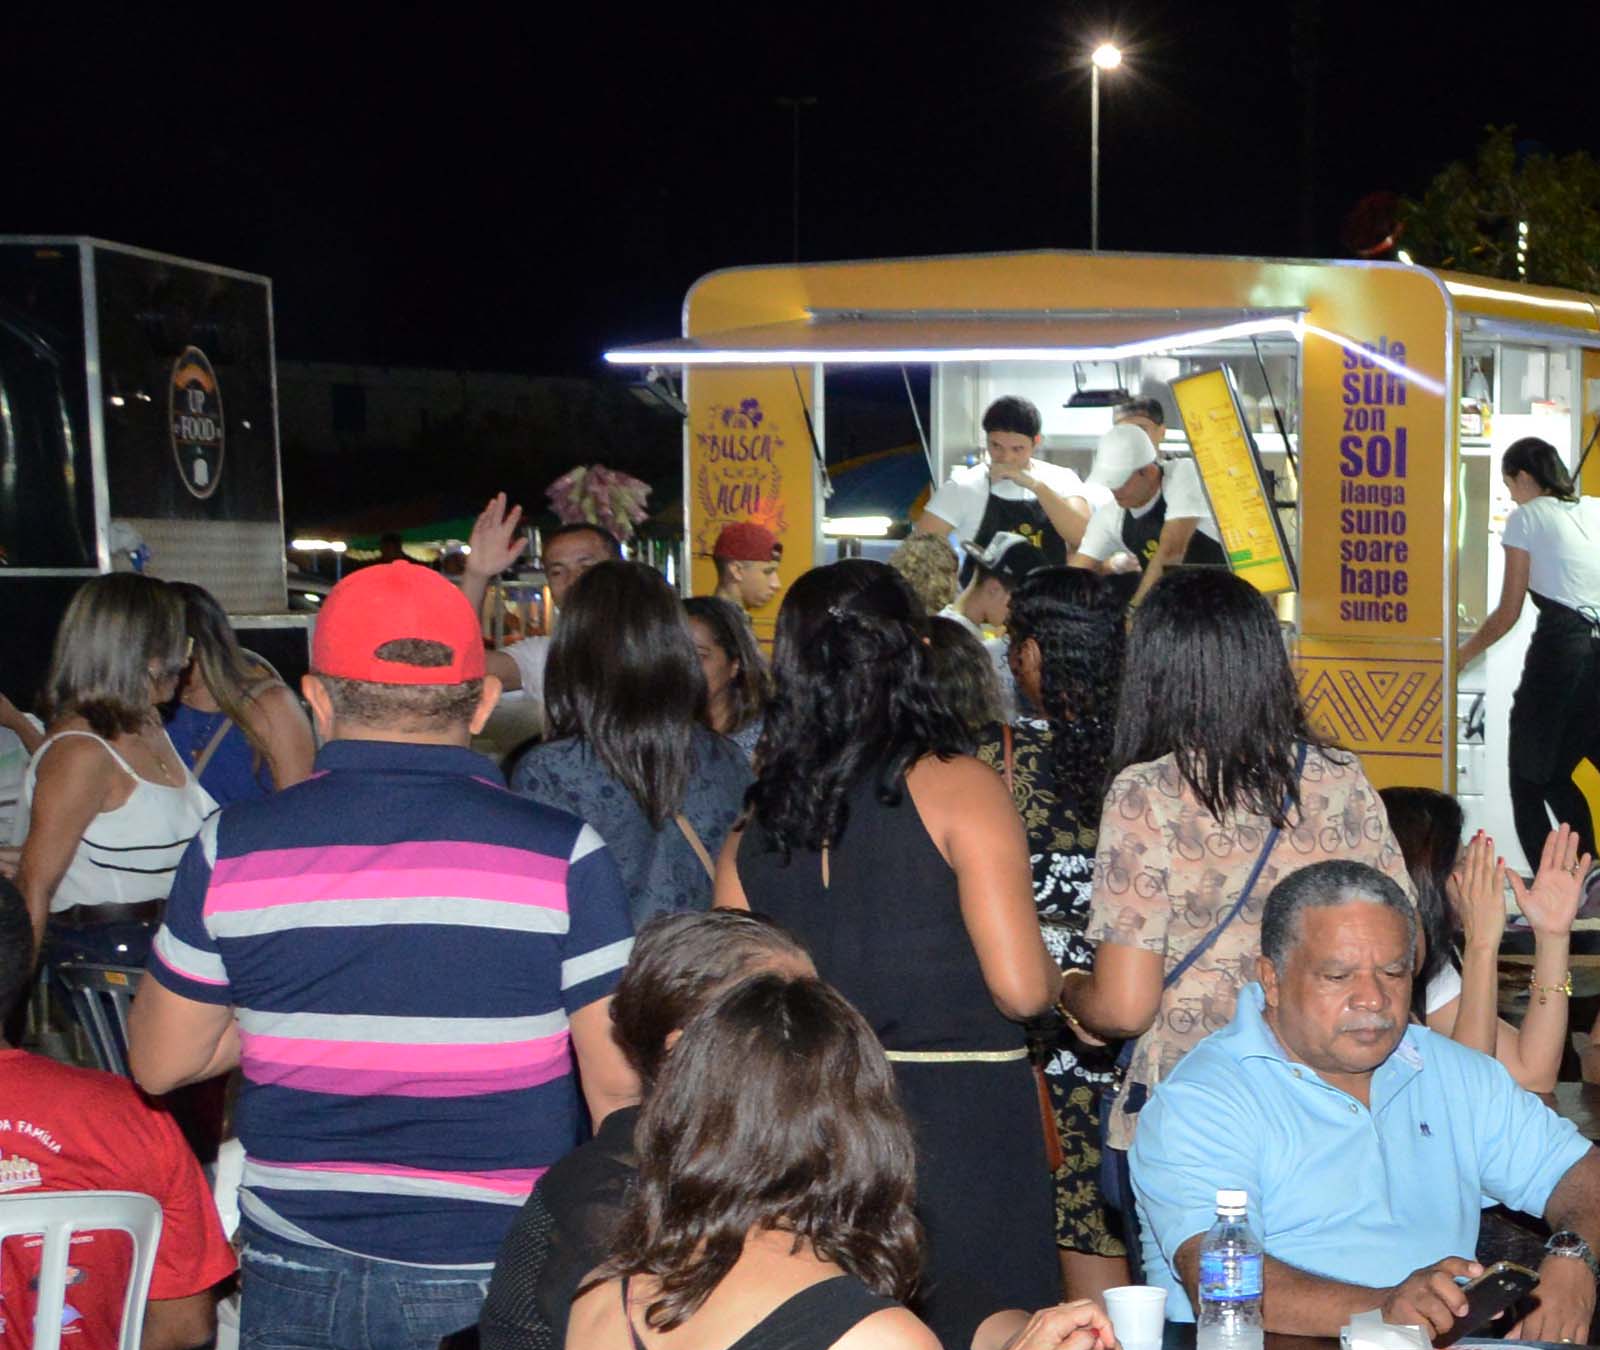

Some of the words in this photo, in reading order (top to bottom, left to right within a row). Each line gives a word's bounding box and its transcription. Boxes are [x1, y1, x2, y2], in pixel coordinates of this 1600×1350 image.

[1342, 373, 1406, 406] sun
[181, 415, 216, 441] FOOD
[1343, 407, 1386, 432] zon
[709, 433, 774, 463] BUSCA
[1340, 427, 1407, 478] sol
[1340, 479, 1405, 507] ilanga
[1341, 508, 1407, 536] suno
[1340, 540, 1408, 563] soare
[1340, 563, 1409, 598] hape
[1340, 600, 1408, 623] sunce
